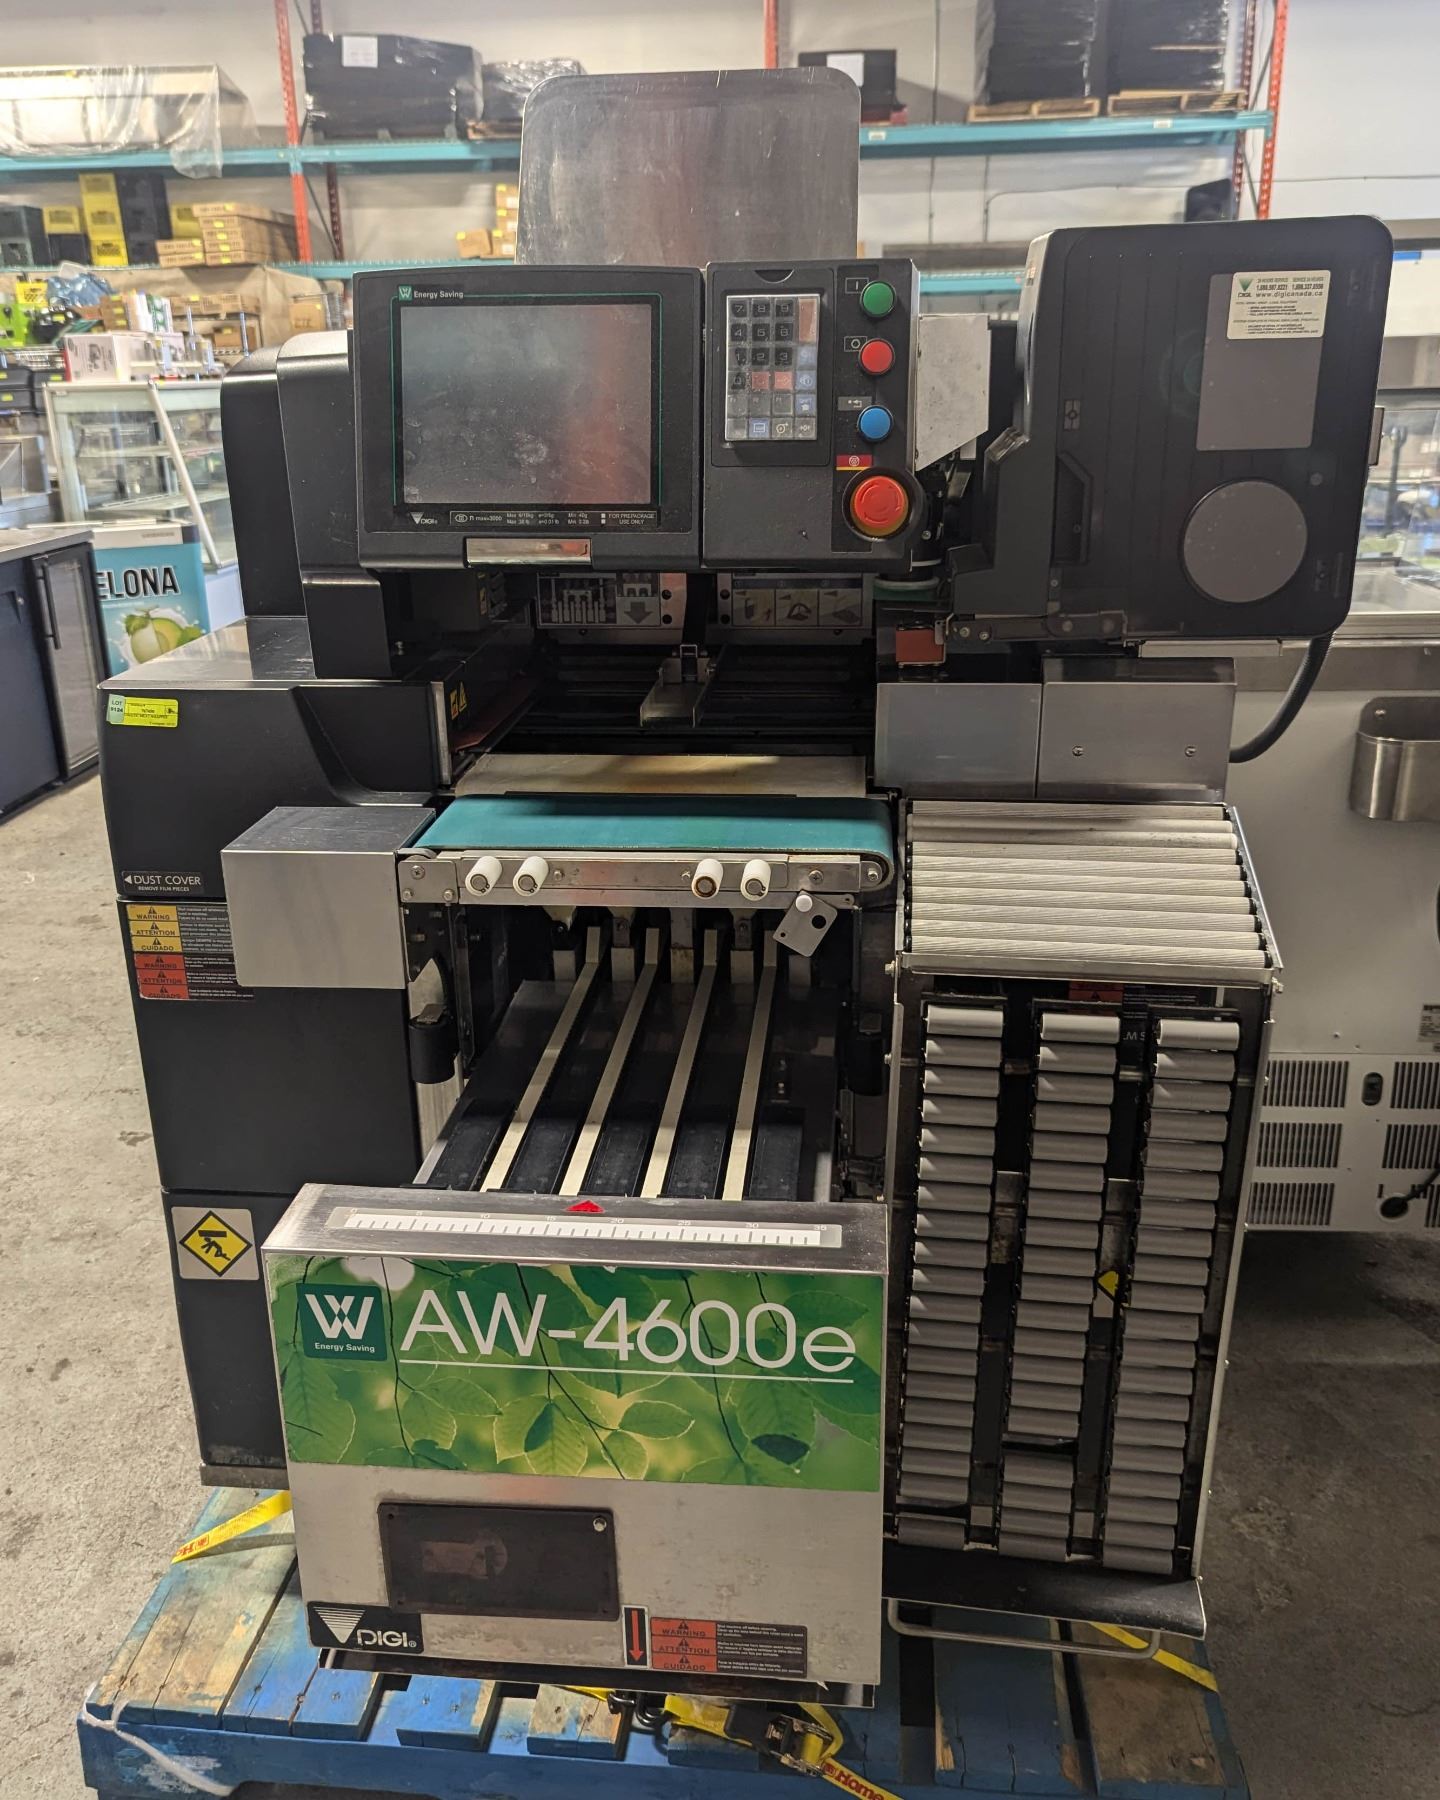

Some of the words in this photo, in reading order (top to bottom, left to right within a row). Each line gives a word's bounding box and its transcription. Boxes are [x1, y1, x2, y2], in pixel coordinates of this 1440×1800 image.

[414, 290, 438, 300] Energy
[440, 290, 464, 300] Saving
[96, 564, 180, 601] ELONA
[134, 876, 162, 885] DUST
[164, 876, 201, 886] COVER
[401, 1290, 855, 1373] AW-4600e
[314, 1342, 344, 1352] Energy
[346, 1344, 375, 1353] Saving
[662, 1628, 706, 1637] WARNING
[660, 1645, 710, 1654] ATTENTION
[664, 1662, 706, 1671] CUIDADO
